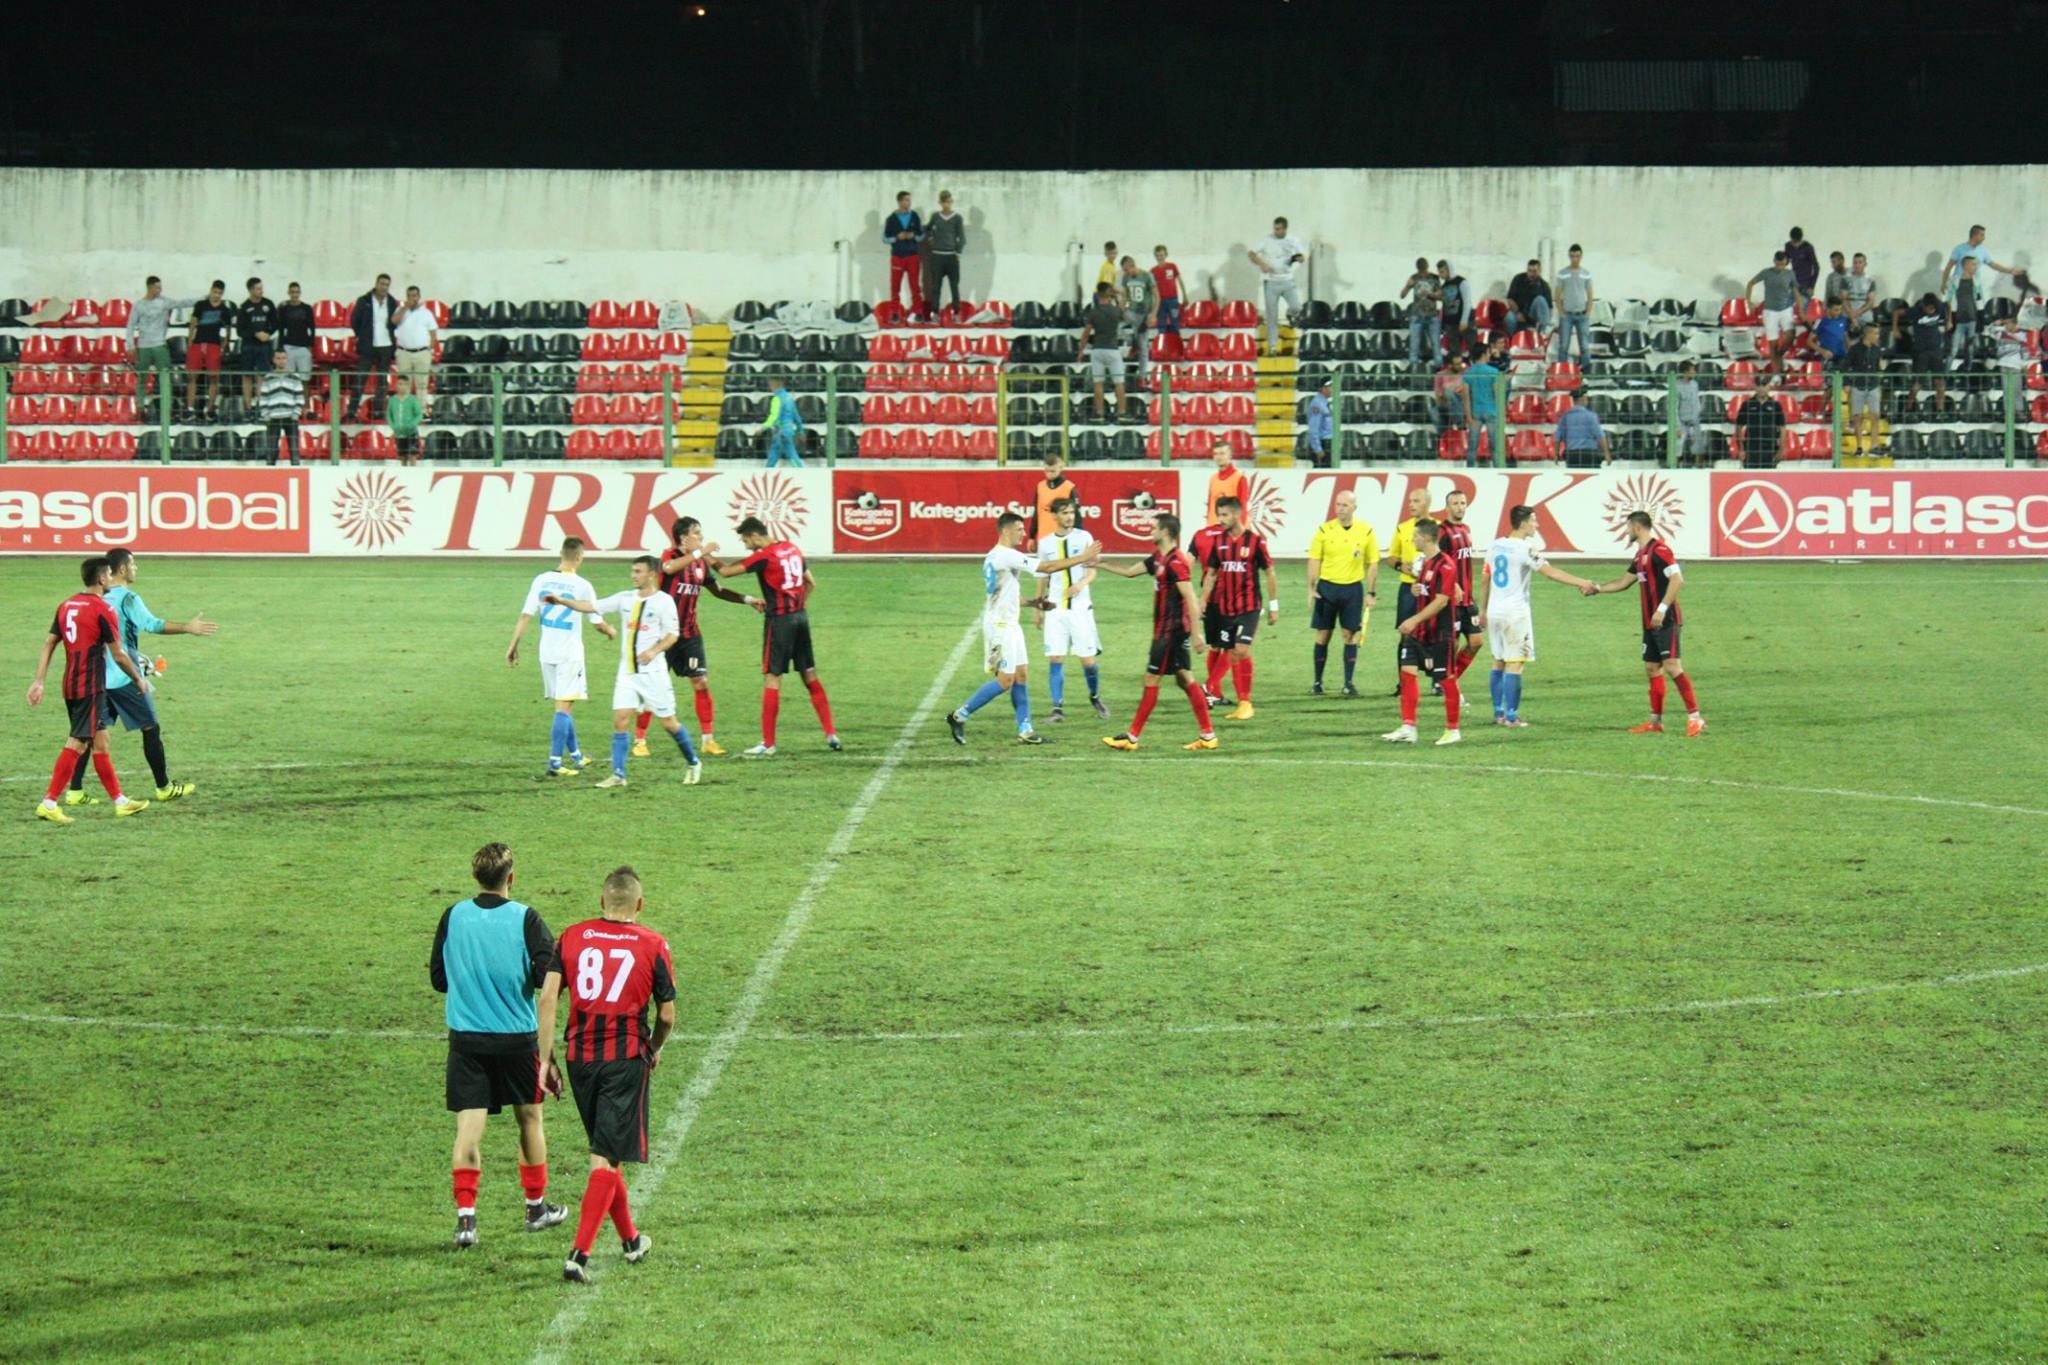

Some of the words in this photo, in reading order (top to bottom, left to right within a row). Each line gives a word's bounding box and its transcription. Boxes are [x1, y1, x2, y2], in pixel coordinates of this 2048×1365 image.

[429, 471, 723, 552] TRK
[910, 501, 1005, 523] Kategoria
[1798, 539, 2017, 549] AIRLINES
[780, 555, 803, 590] 19
[1222, 561, 1247, 572] TRK
[1493, 554, 1509, 588] 8
[66, 609, 79, 644] 5
[539, 590, 576, 630] 22
[577, 947, 636, 1002] 87
